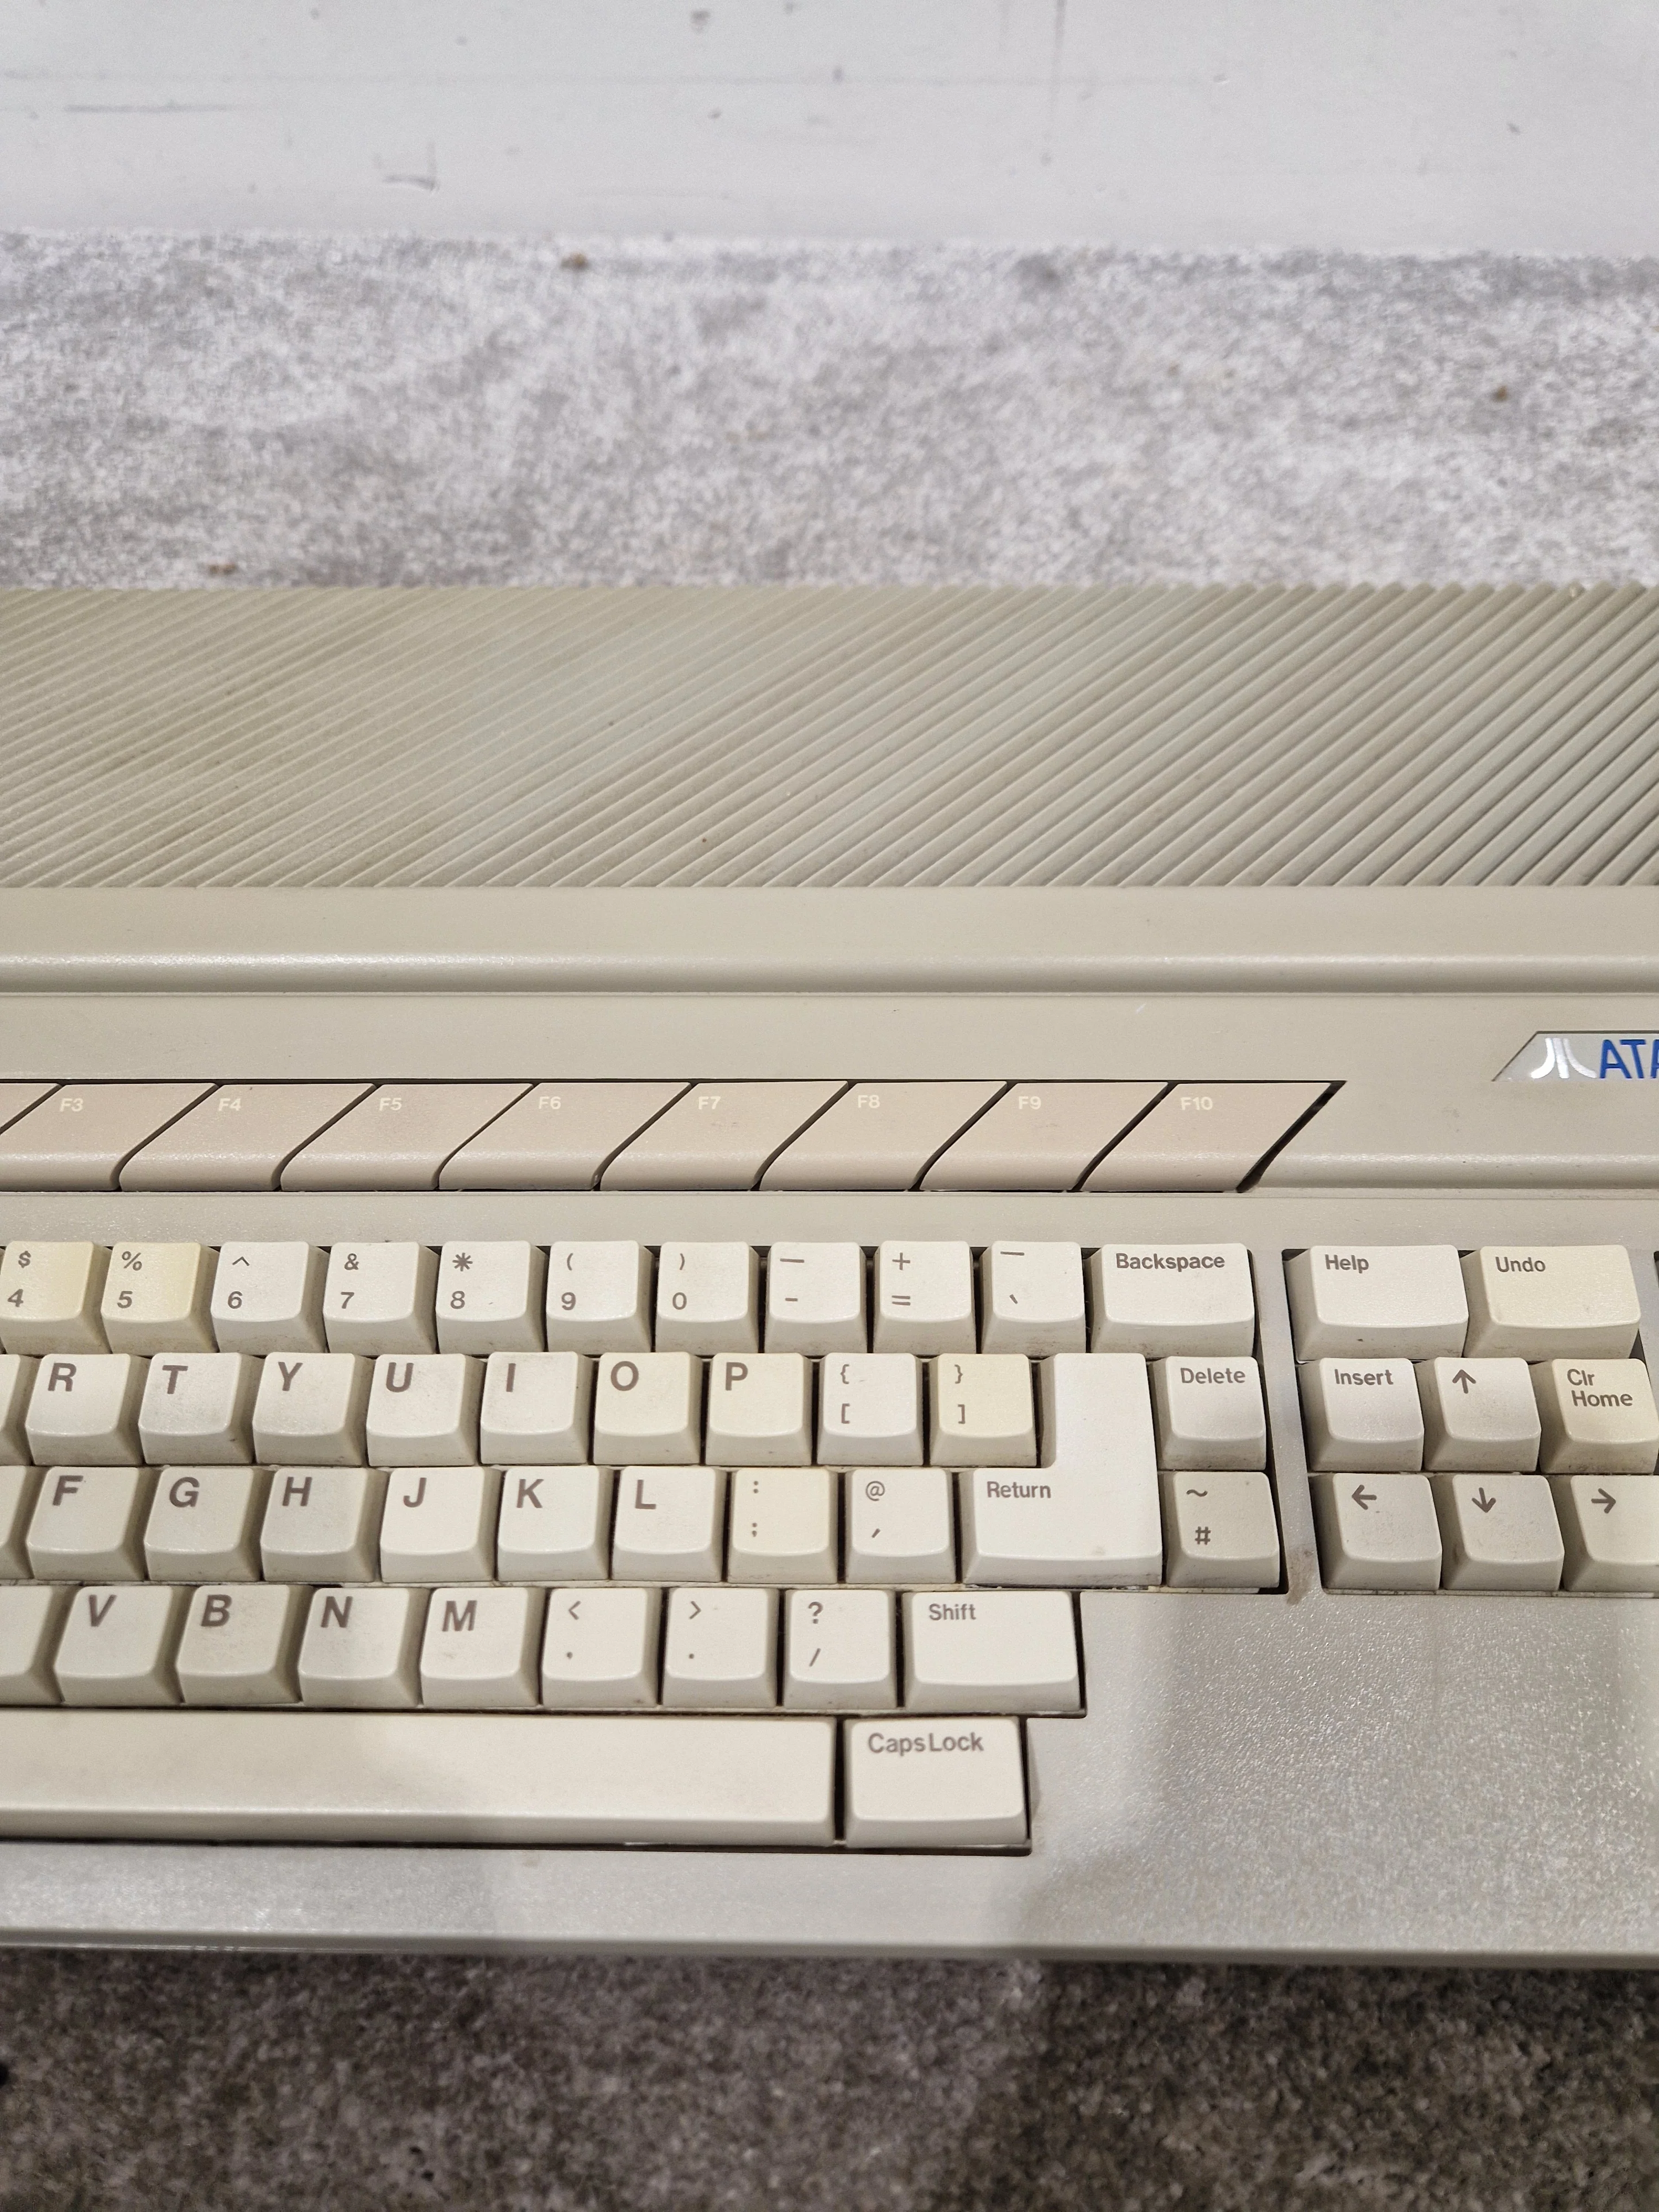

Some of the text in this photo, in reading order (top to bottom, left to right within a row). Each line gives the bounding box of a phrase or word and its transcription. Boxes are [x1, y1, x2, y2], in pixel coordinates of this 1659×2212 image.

[1600, 1040, 1659, 1079] AT
[60, 1098, 84, 1112] F3
[218, 1098, 241, 1112] F4
[379, 1097, 402, 1111] F5
[539, 1096, 561, 1109] F6
[698, 1095, 721, 1110] F7
[858, 1094, 880, 1109] F8
[1018, 1095, 1041, 1110] F9
[1180, 1096, 1213, 1110] F10
[1116, 1253, 1225, 1272] Backspace
[1325, 1254, 1369, 1274] Help
[1495, 1256, 1546, 1272] Undo
[7, 1288, 24, 1307] 4
[117, 1290, 133, 1309] 5
[227, 1291, 243, 1309] 6
[341, 1291, 354, 1309] 7
[450, 1291, 465, 1310] 8
[561, 1292, 576, 1311] 9
[672, 1292, 687, 1310] 0
[48, 1363, 77, 1392] R
[162, 1365, 189, 1395] T
[278, 1361, 303, 1392] Y
[385, 1362, 414, 1393] U
[611, 1360, 639, 1391] O
[725, 1361, 748, 1391] P
[1180, 1368, 1245, 1384] Delete
[1334, 1369, 1394, 1386] Insert
[1567, 1369, 1595, 1386] Clr
[1571, 1390, 1633, 1407] Home
[52, 1475, 84, 1506] F
[169, 1477, 200, 1508] G
[282, 1477, 312, 1507] H
[403, 1477, 427, 1508] J
[517, 1479, 544, 1509] K
[635, 1479, 656, 1510] L
[987, 1481, 1051, 1499] Return
[88, 1594, 116, 1627] V
[200, 1594, 232, 1627] B
[320, 1596, 352, 1628] N
[442, 1600, 477, 1632] M
[929, 1603, 976, 1621] Shift
